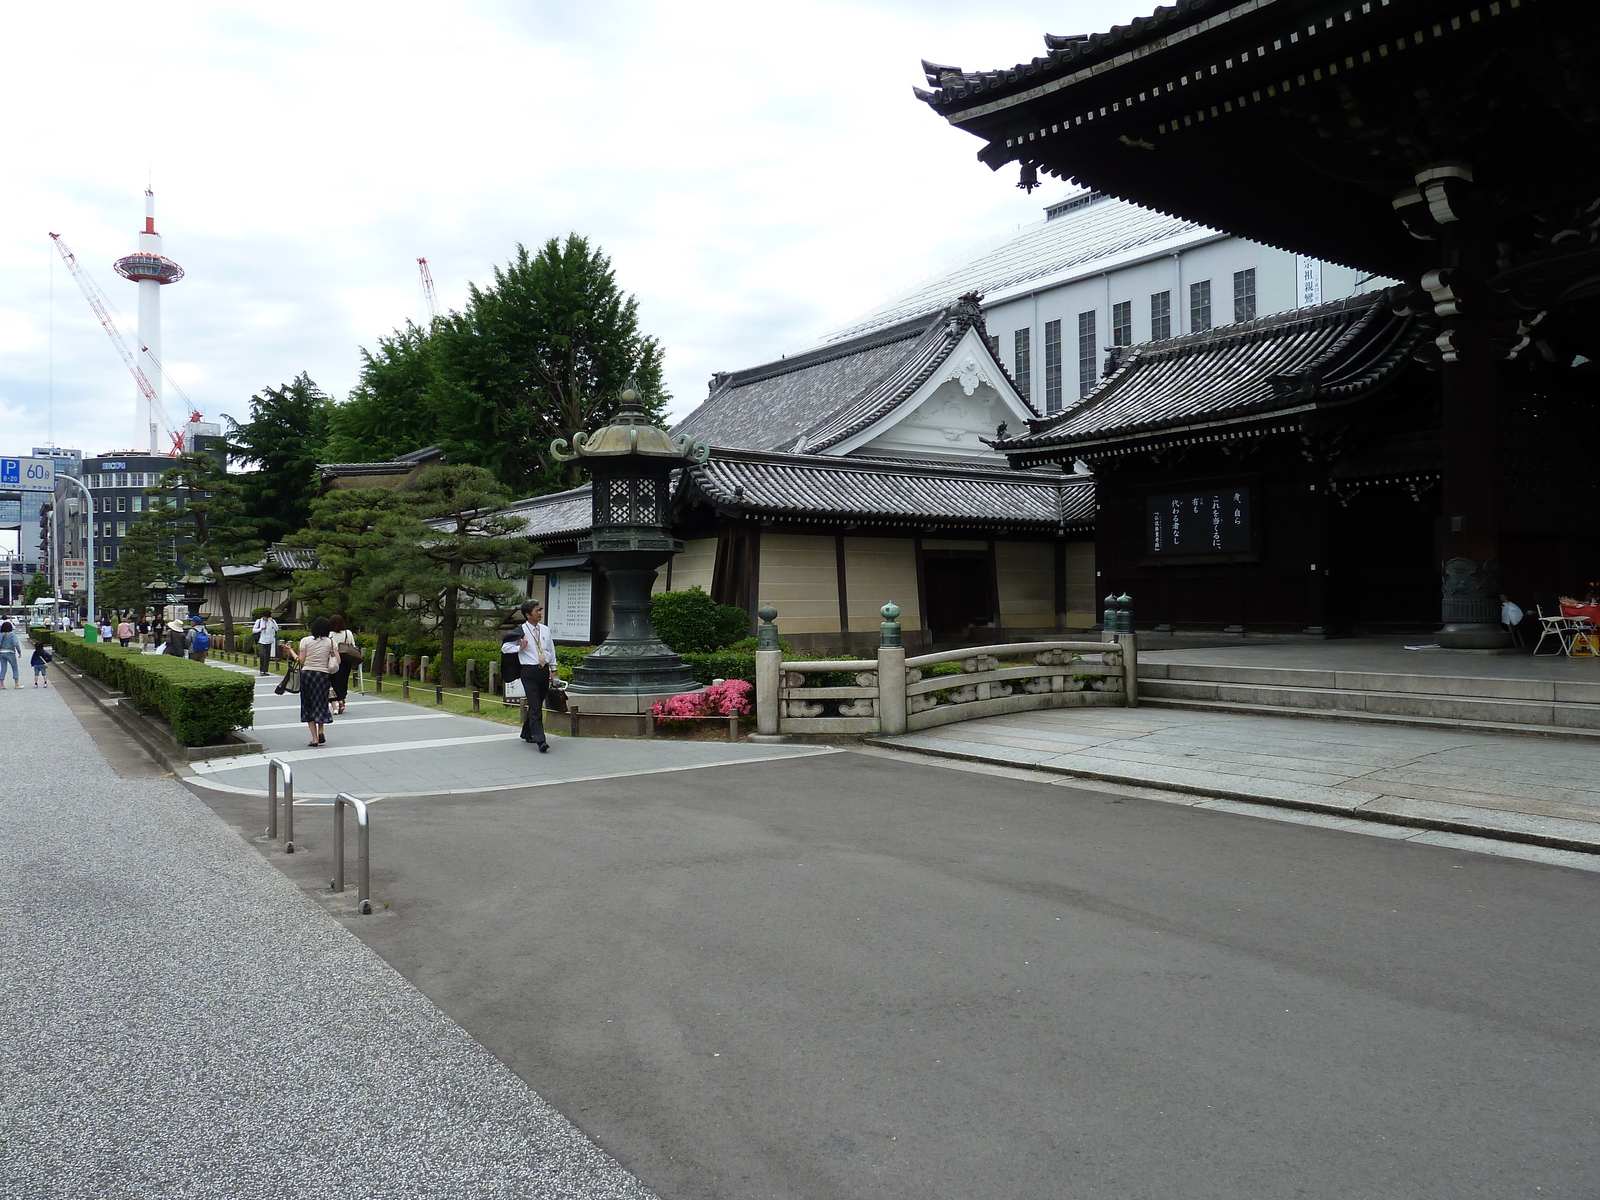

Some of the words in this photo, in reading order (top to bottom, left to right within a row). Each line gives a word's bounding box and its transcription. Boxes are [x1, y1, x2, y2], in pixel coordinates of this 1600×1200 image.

[6, 460, 17, 475] P
[1171, 499, 1180, 545] 代わる者なし
